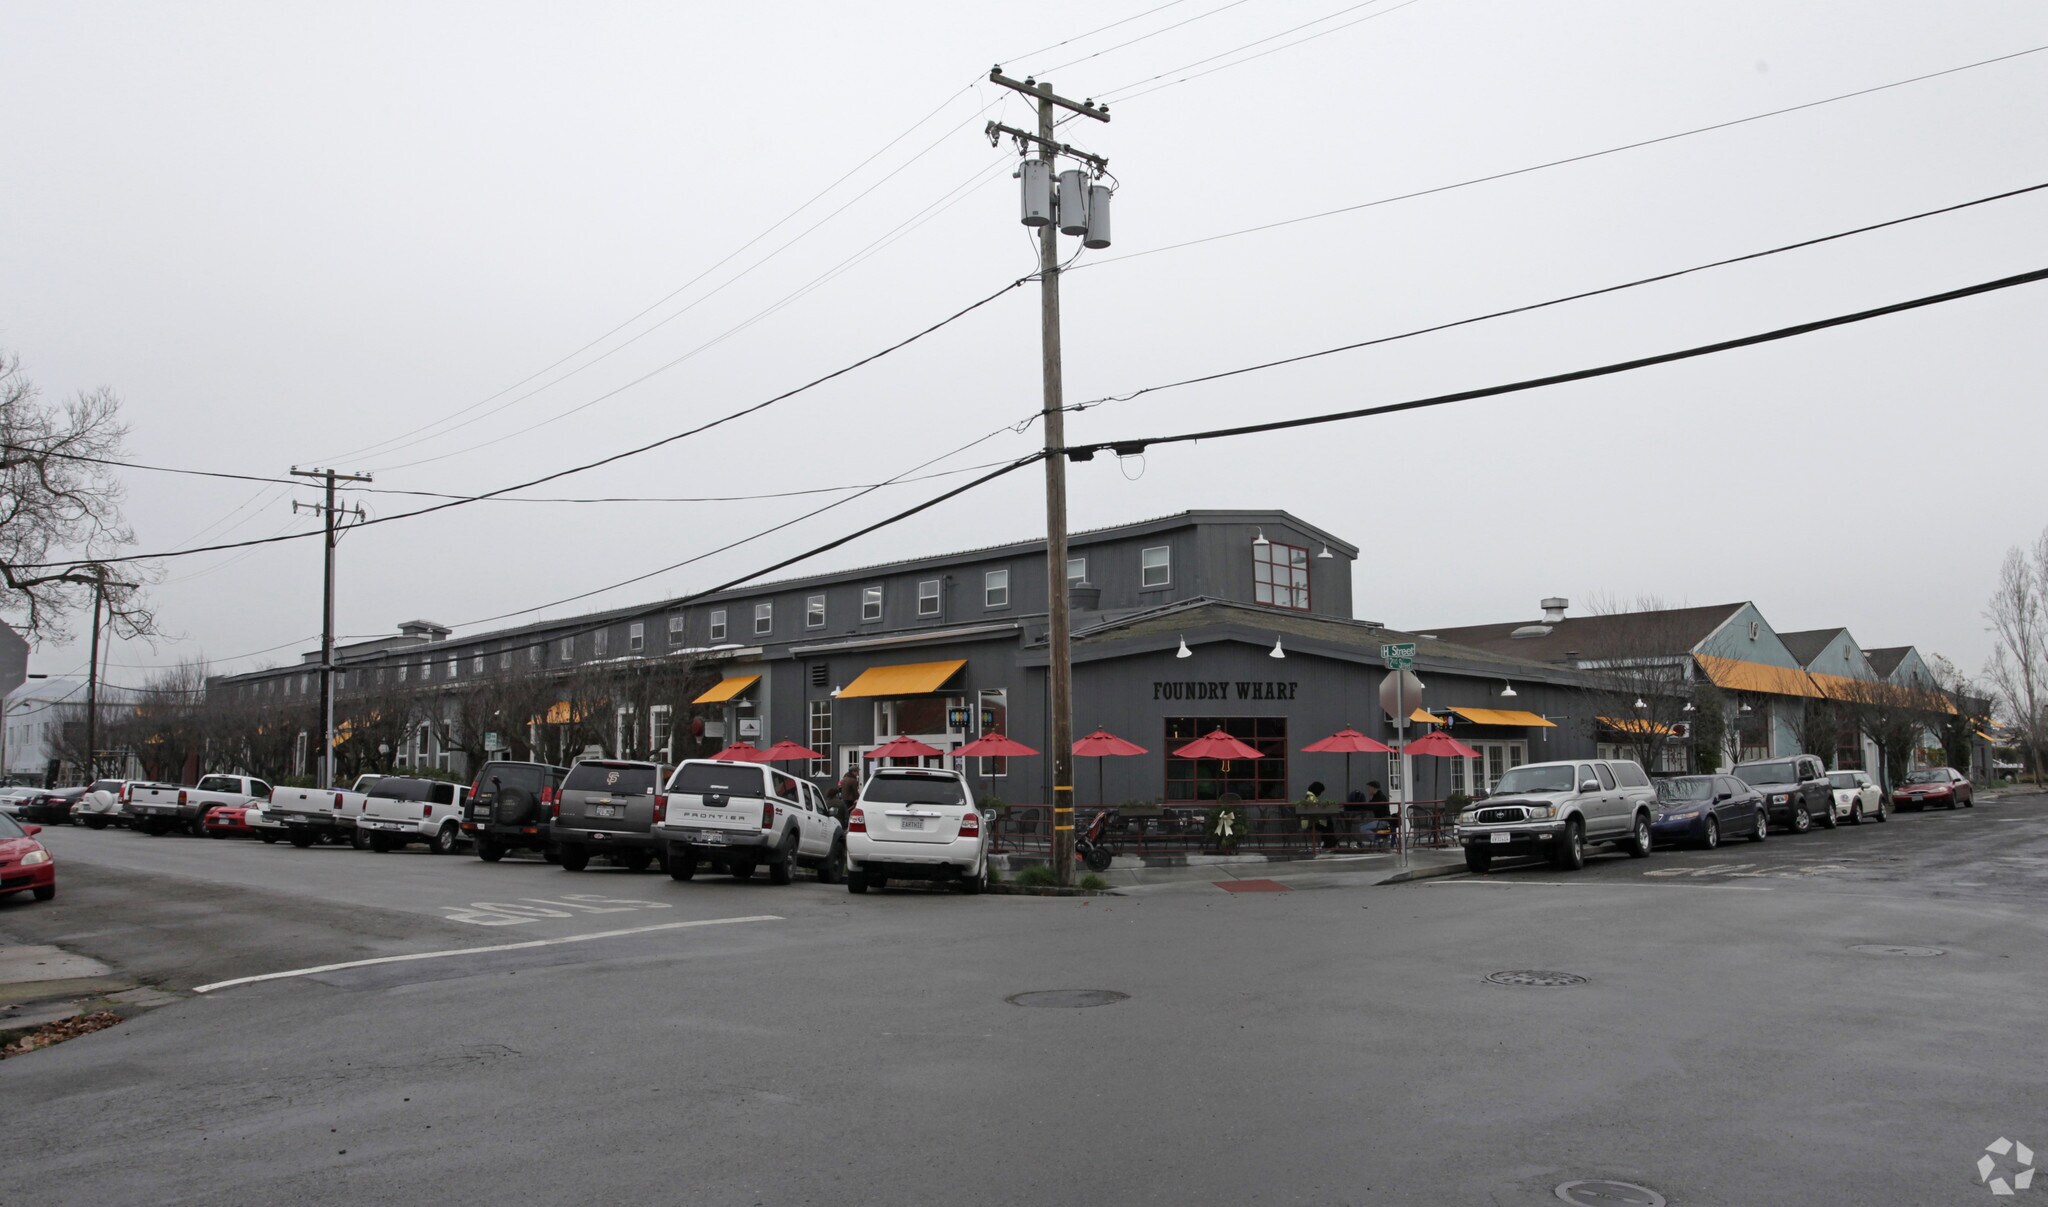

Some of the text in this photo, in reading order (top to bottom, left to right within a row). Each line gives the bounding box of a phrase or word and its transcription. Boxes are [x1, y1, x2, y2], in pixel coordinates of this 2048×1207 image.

[1384, 645, 1415, 657] H Street
[1152, 682, 1298, 700] FOUNDRY WHARF
[683, 812, 745, 821] FRONTIER
[439, 894, 673, 926] STOP
